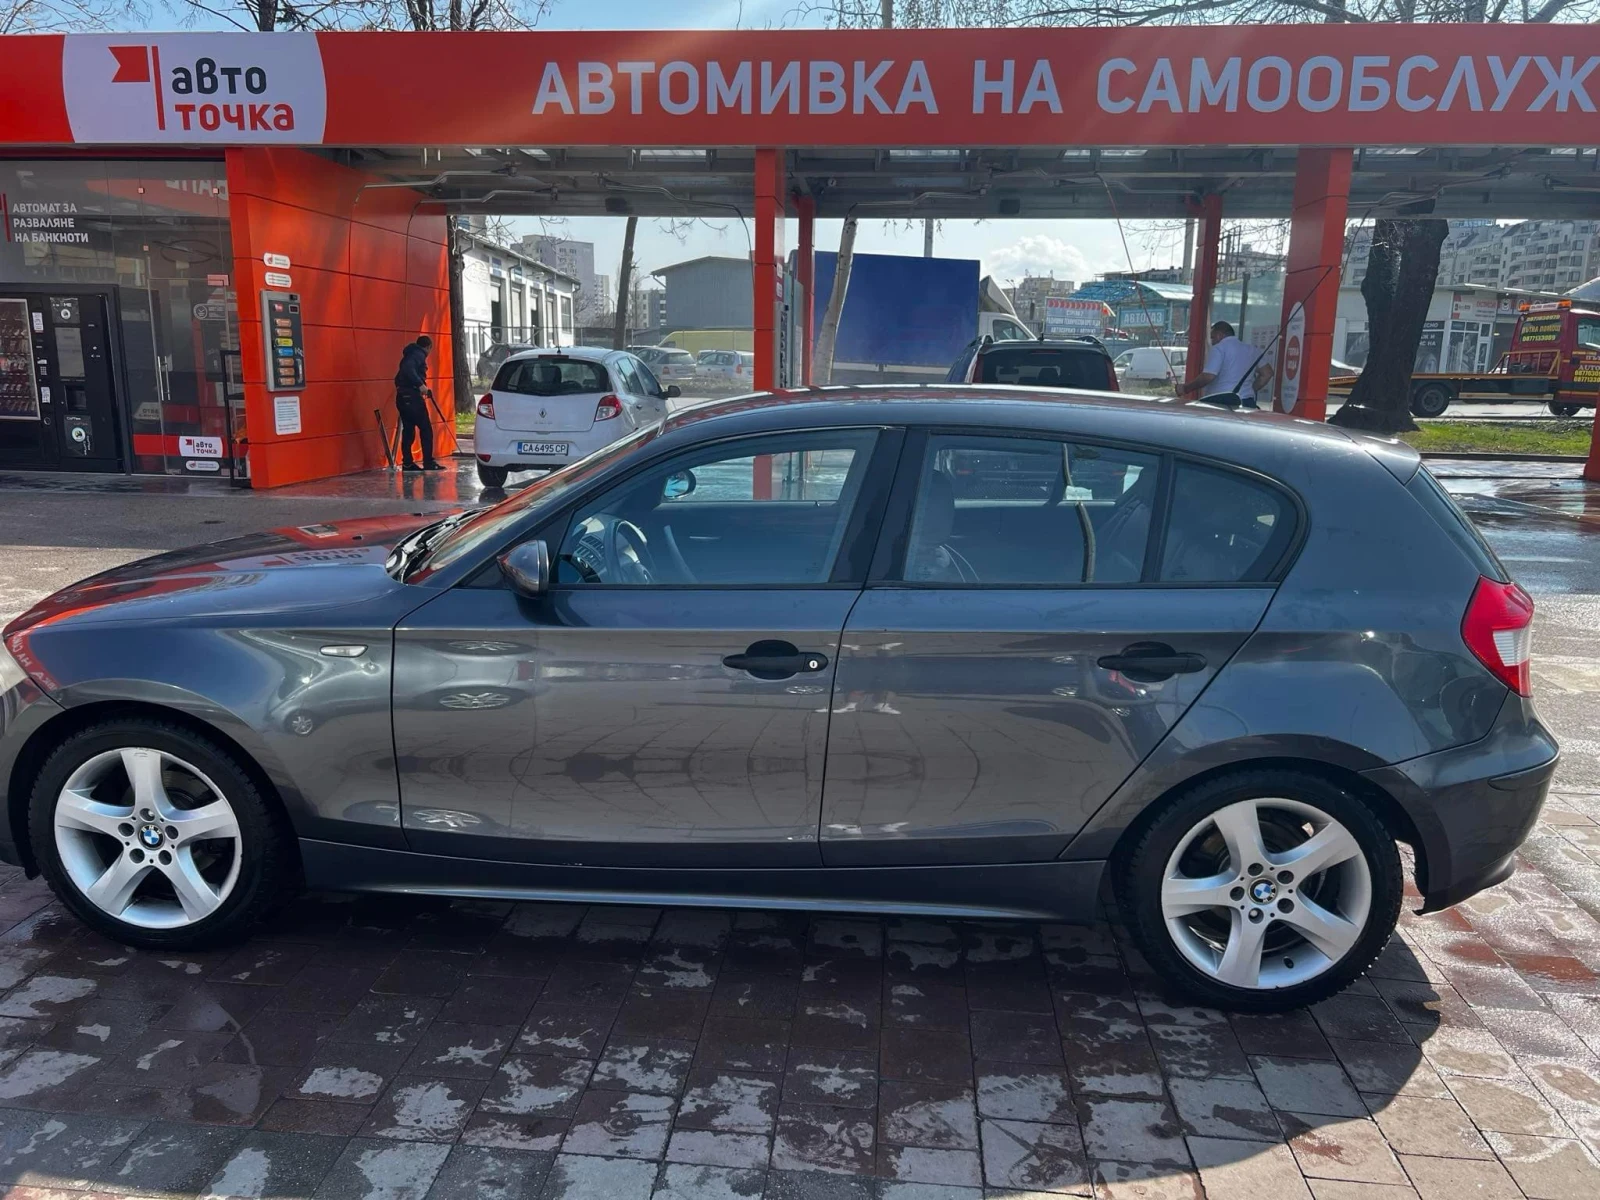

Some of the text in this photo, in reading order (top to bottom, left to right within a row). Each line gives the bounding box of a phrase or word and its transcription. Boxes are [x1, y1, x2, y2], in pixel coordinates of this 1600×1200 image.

[172, 57, 267, 95] авто
[532, 55, 1600, 116] АВТОМИВКА НА САМООБСЛУЖ
[175, 103, 295, 132] точка
[12, 203, 77, 214] АВТОМАТ ЗА
[13, 217, 75, 229] РАЗВАЛЯНЕ
[15, 232, 89, 244] НА БАНКНОТИ
[522, 443, 566, 453] CA 6495 CP
